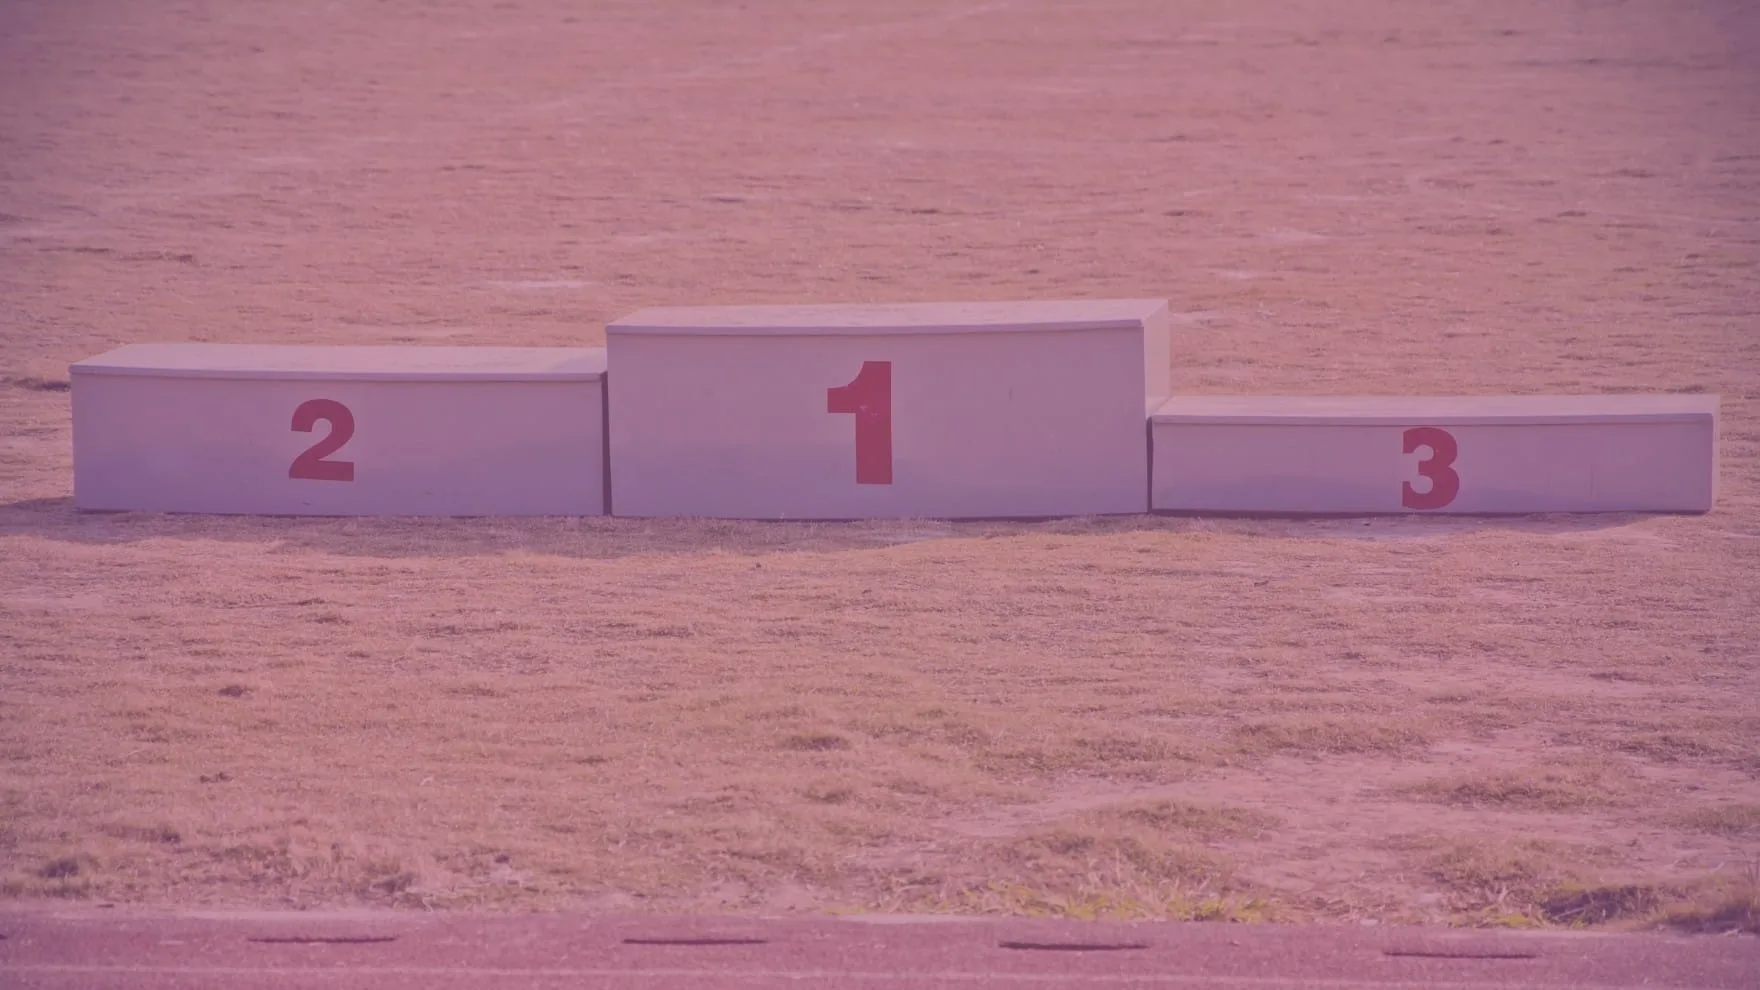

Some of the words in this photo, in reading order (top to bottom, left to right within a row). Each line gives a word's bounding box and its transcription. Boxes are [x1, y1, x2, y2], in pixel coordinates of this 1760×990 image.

[289, 398, 355, 481] 2
[827, 361, 893, 485] 1
[1402, 427, 1460, 509] 3
